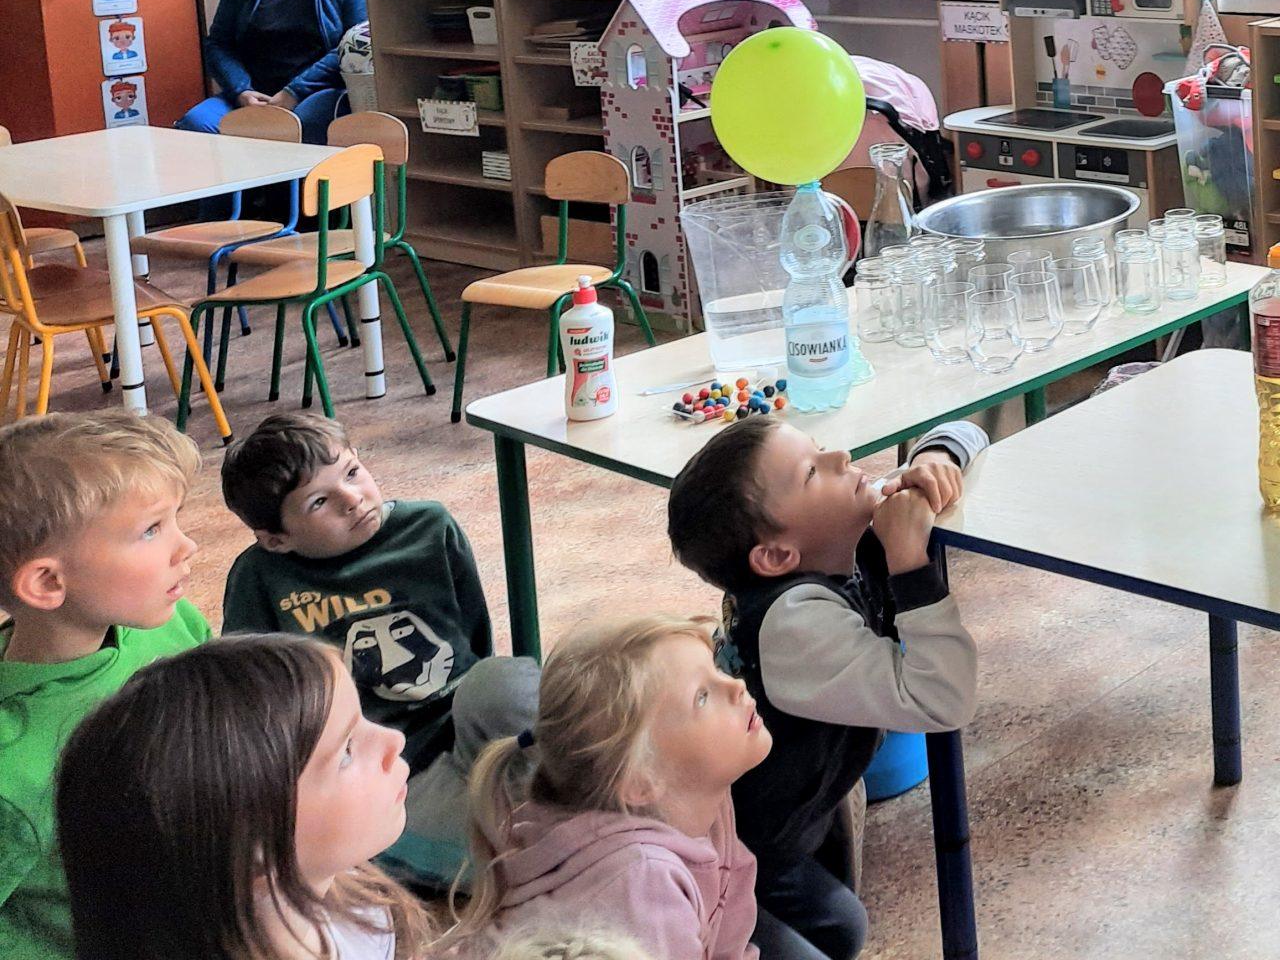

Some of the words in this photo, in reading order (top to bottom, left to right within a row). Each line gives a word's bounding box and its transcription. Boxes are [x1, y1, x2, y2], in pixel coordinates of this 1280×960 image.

[954, 24, 1002, 36] MASKOTEK
[280, 591, 321, 611] stay
[292, 589, 392, 633] WILD
